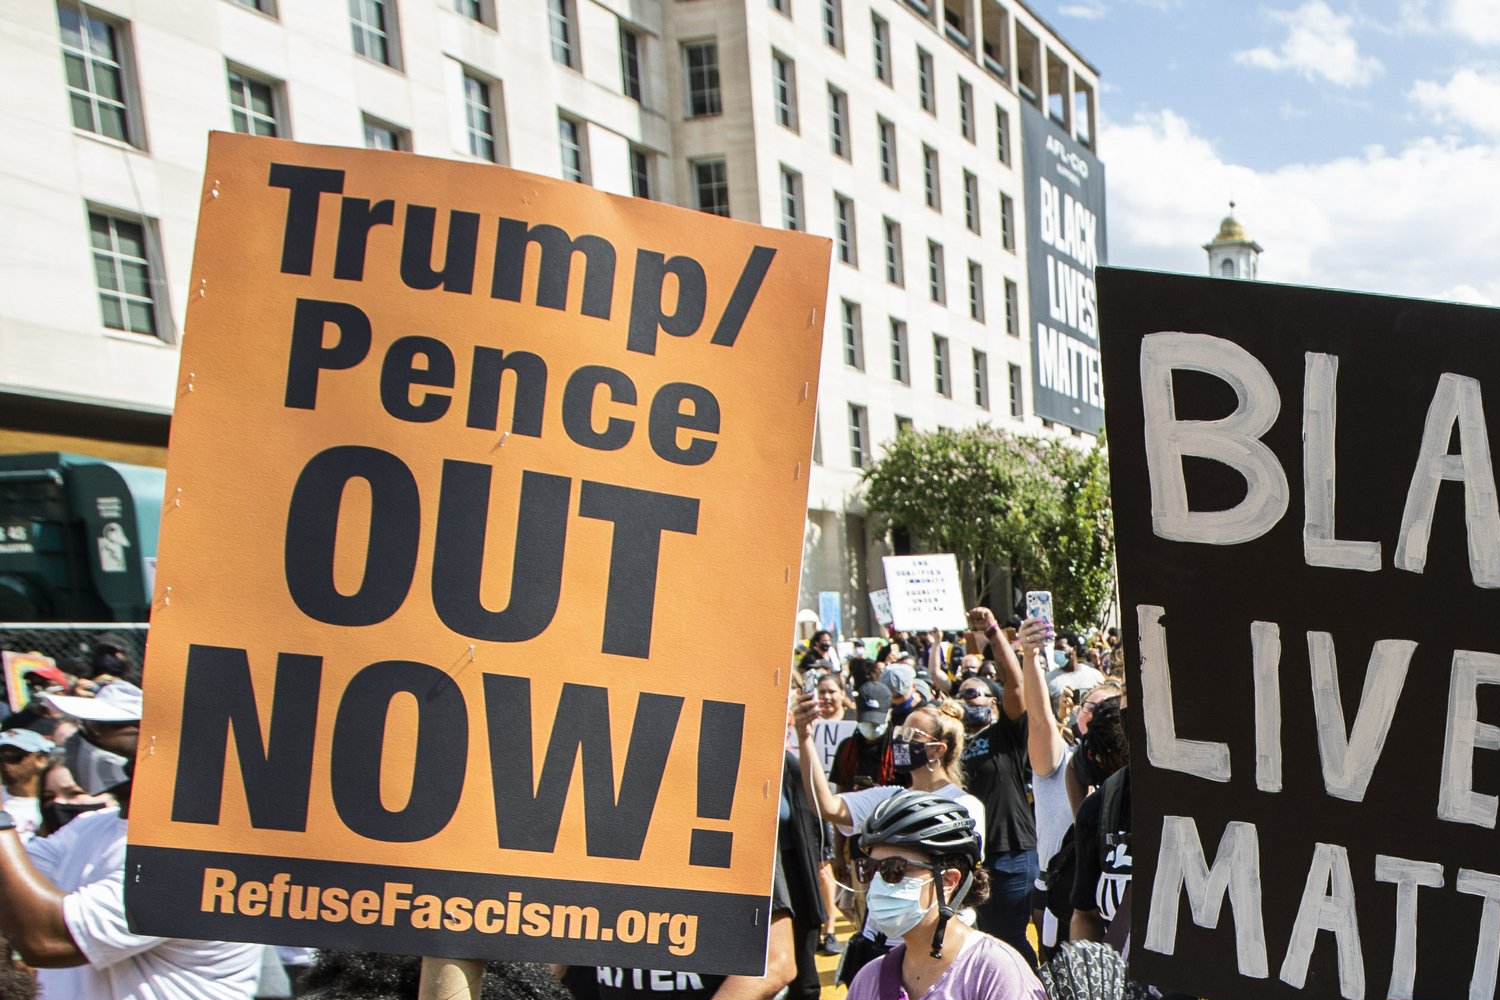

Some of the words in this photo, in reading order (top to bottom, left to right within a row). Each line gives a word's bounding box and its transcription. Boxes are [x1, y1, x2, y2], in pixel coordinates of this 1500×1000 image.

[268, 163, 777, 355] Trump/
[1040, 176, 1097, 270] BLACK
[1047, 255, 1096, 340] LIVES
[284, 298, 722, 466] Pence
[1037, 322, 1105, 410] MATTE
[284, 444, 700, 660] OUT
[171, 643, 746, 869] NOW!
[201, 868, 698, 956] RefuseFascism.org
